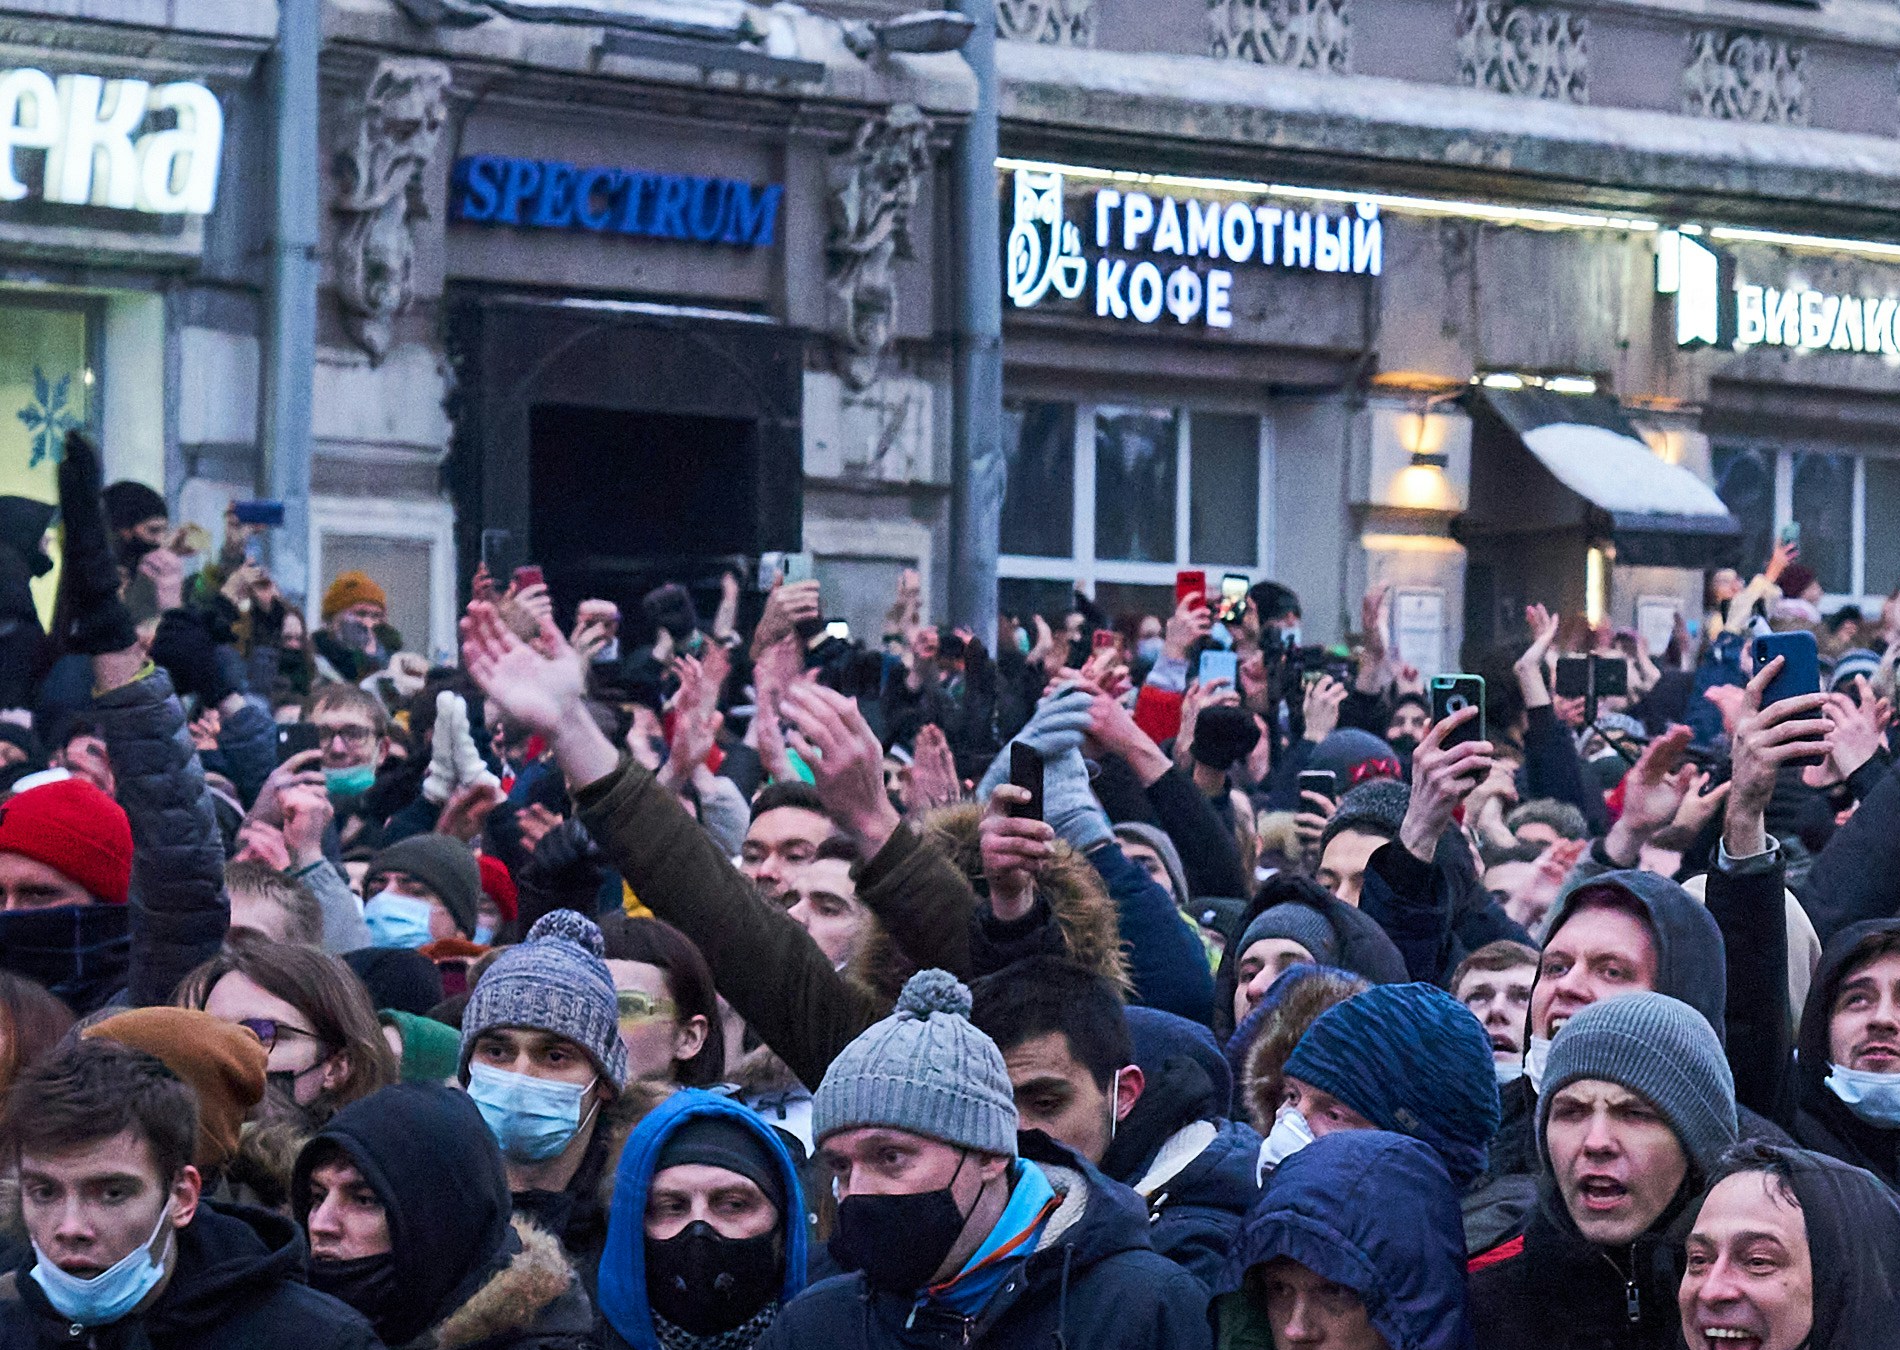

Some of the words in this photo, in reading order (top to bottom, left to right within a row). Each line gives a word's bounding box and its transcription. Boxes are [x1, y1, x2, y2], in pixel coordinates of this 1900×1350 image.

[461, 154, 785, 247] SPECTRUM
[1096, 188, 1383, 276] ГРАМОТНЫЙ
[1096, 257, 1233, 328] КОФЕ
